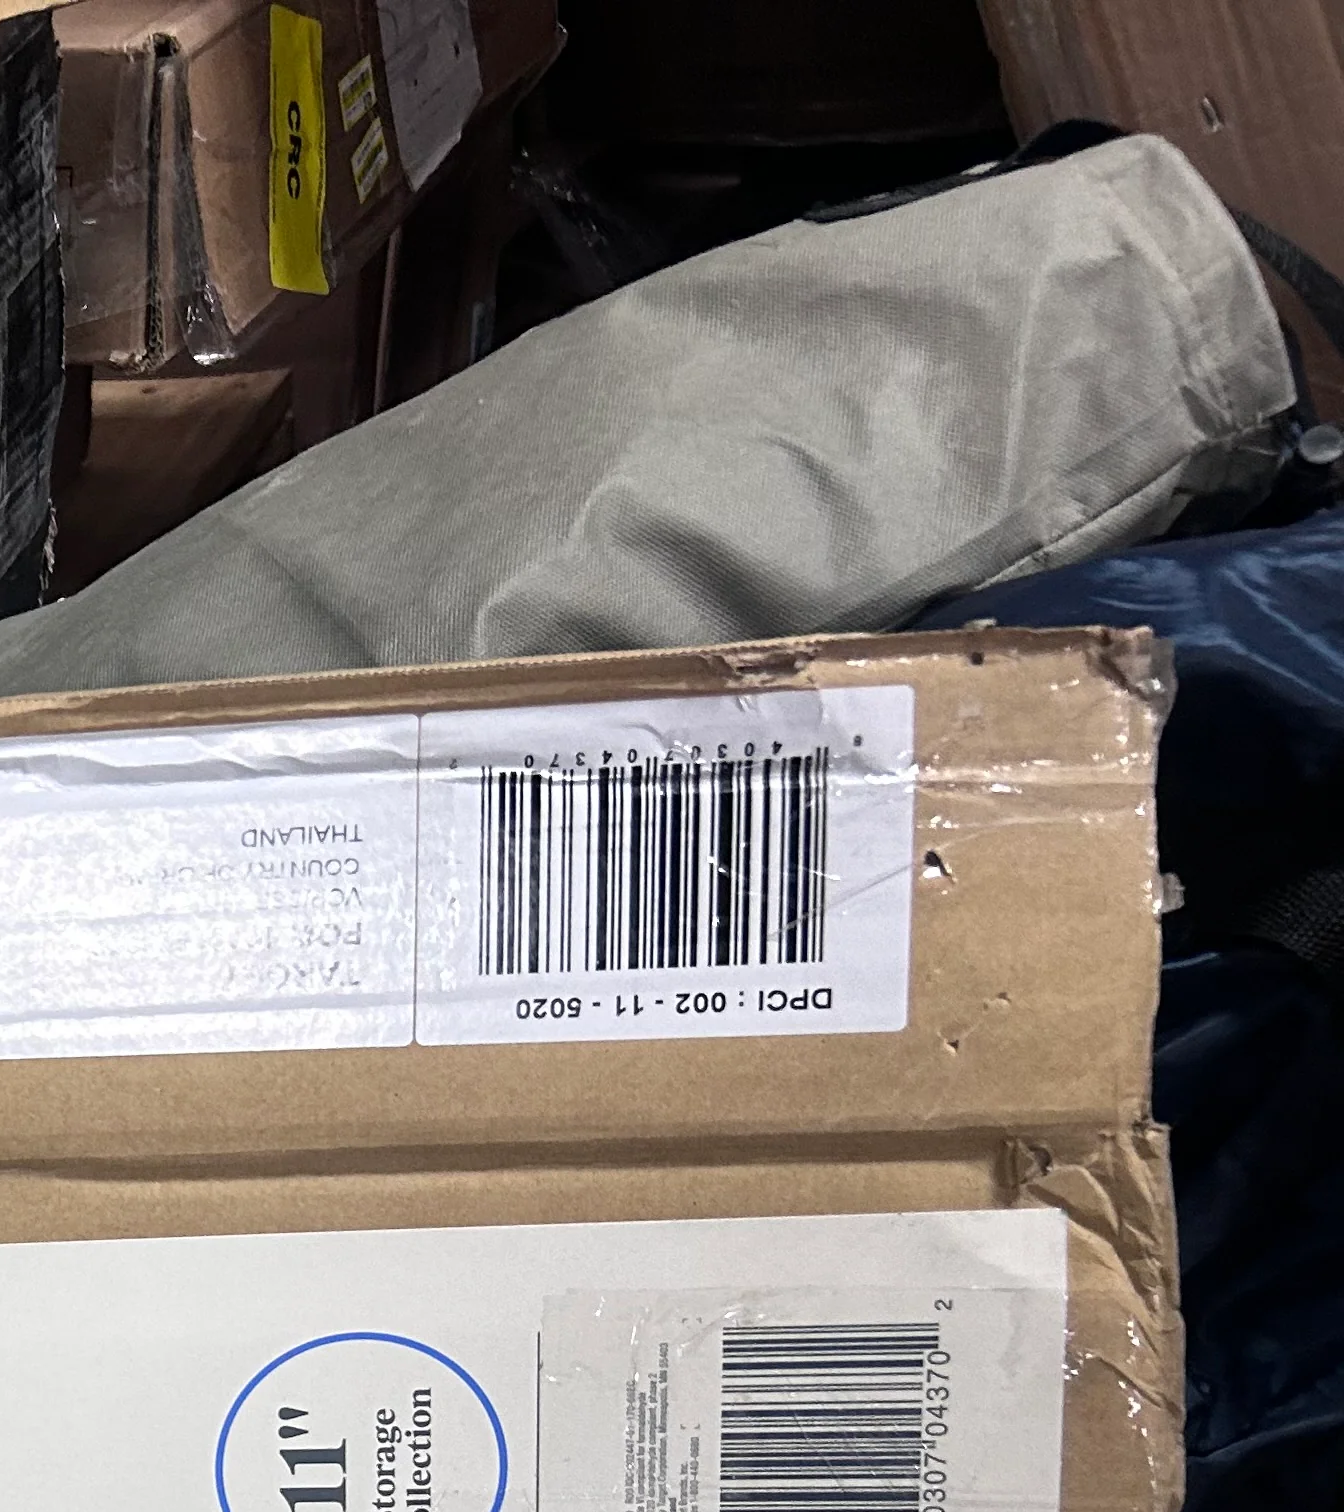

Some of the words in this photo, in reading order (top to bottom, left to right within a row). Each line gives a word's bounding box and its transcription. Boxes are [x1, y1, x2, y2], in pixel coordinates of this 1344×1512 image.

[285, 99, 302, 200] CRC
[240, 823, 364, 848] THAILAND
[515, 996, 582, 1020] 5020
[615, 993, 645, 1016] 11
[675, 991, 727, 1014] 002
[758, 987, 834, 1010] DPCI
[933, 1298, 953, 1310] 2
[922, 1349, 953, 1437] 04370
